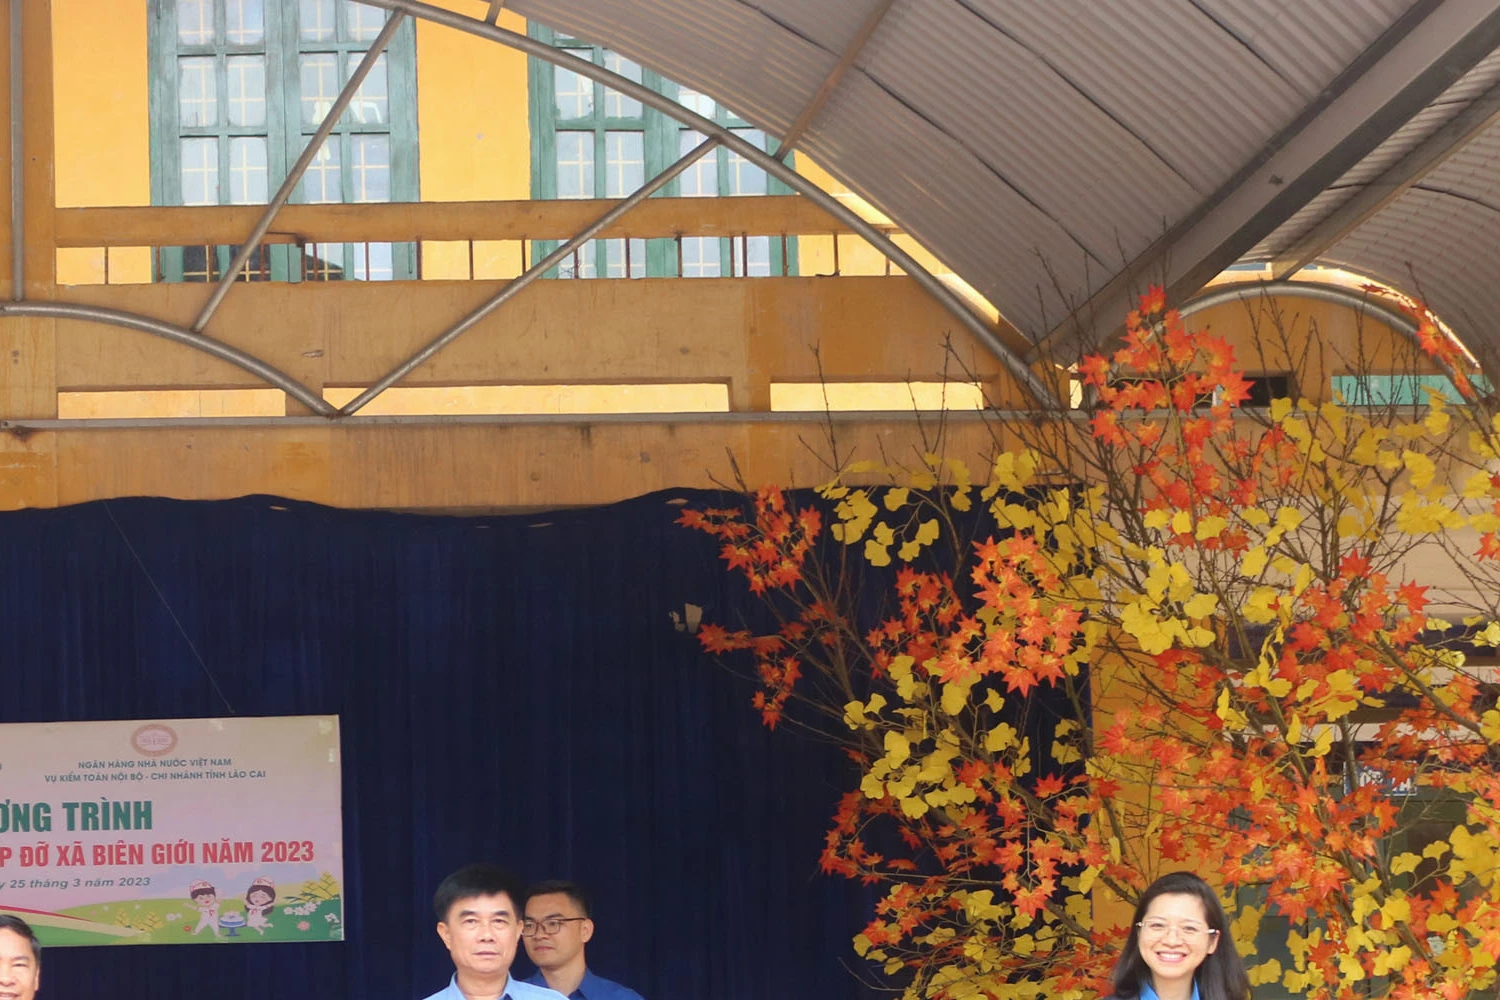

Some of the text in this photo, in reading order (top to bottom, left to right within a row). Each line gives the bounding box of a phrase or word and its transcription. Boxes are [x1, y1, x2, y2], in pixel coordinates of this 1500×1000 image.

[78, 758, 105, 768] NGÂN
[108, 758, 135, 768] HÀNG
[138, 757, 157, 768] NHÀ
[190, 757, 207, 768] VIỆT
[210, 758, 232, 766] NAM
[44, 774, 57, 784] VỤ
[59, 772, 81, 782] KIỂM
[83, 772, 108, 781] TOÁN
[110, 772, 128, 782] NỘI
[130, 771, 144, 782] BỘ
[150, 772, 168, 780] CHI
[170, 770, 202, 780] NHÁNH
[228, 769, 246, 779] LÀO
[249, 770, 266, 778] CAI
[62, 797, 152, 831] TRÌNH
[19, 840, 49, 867] ĐỠ
[56, 840, 86, 866] XÃ
[92, 839, 144, 866] BIÊN
[151, 838, 194, 864] GIỚI
[202, 838, 253, 864] NĂM
[260, 840, 314, 862] 2023
[10, 879, 26, 888] 25
[30, 878, 68, 889] tháng
[72, 878, 81, 887] 3
[84, 878, 114, 887] năm
[118, 876, 151, 886] 2023
